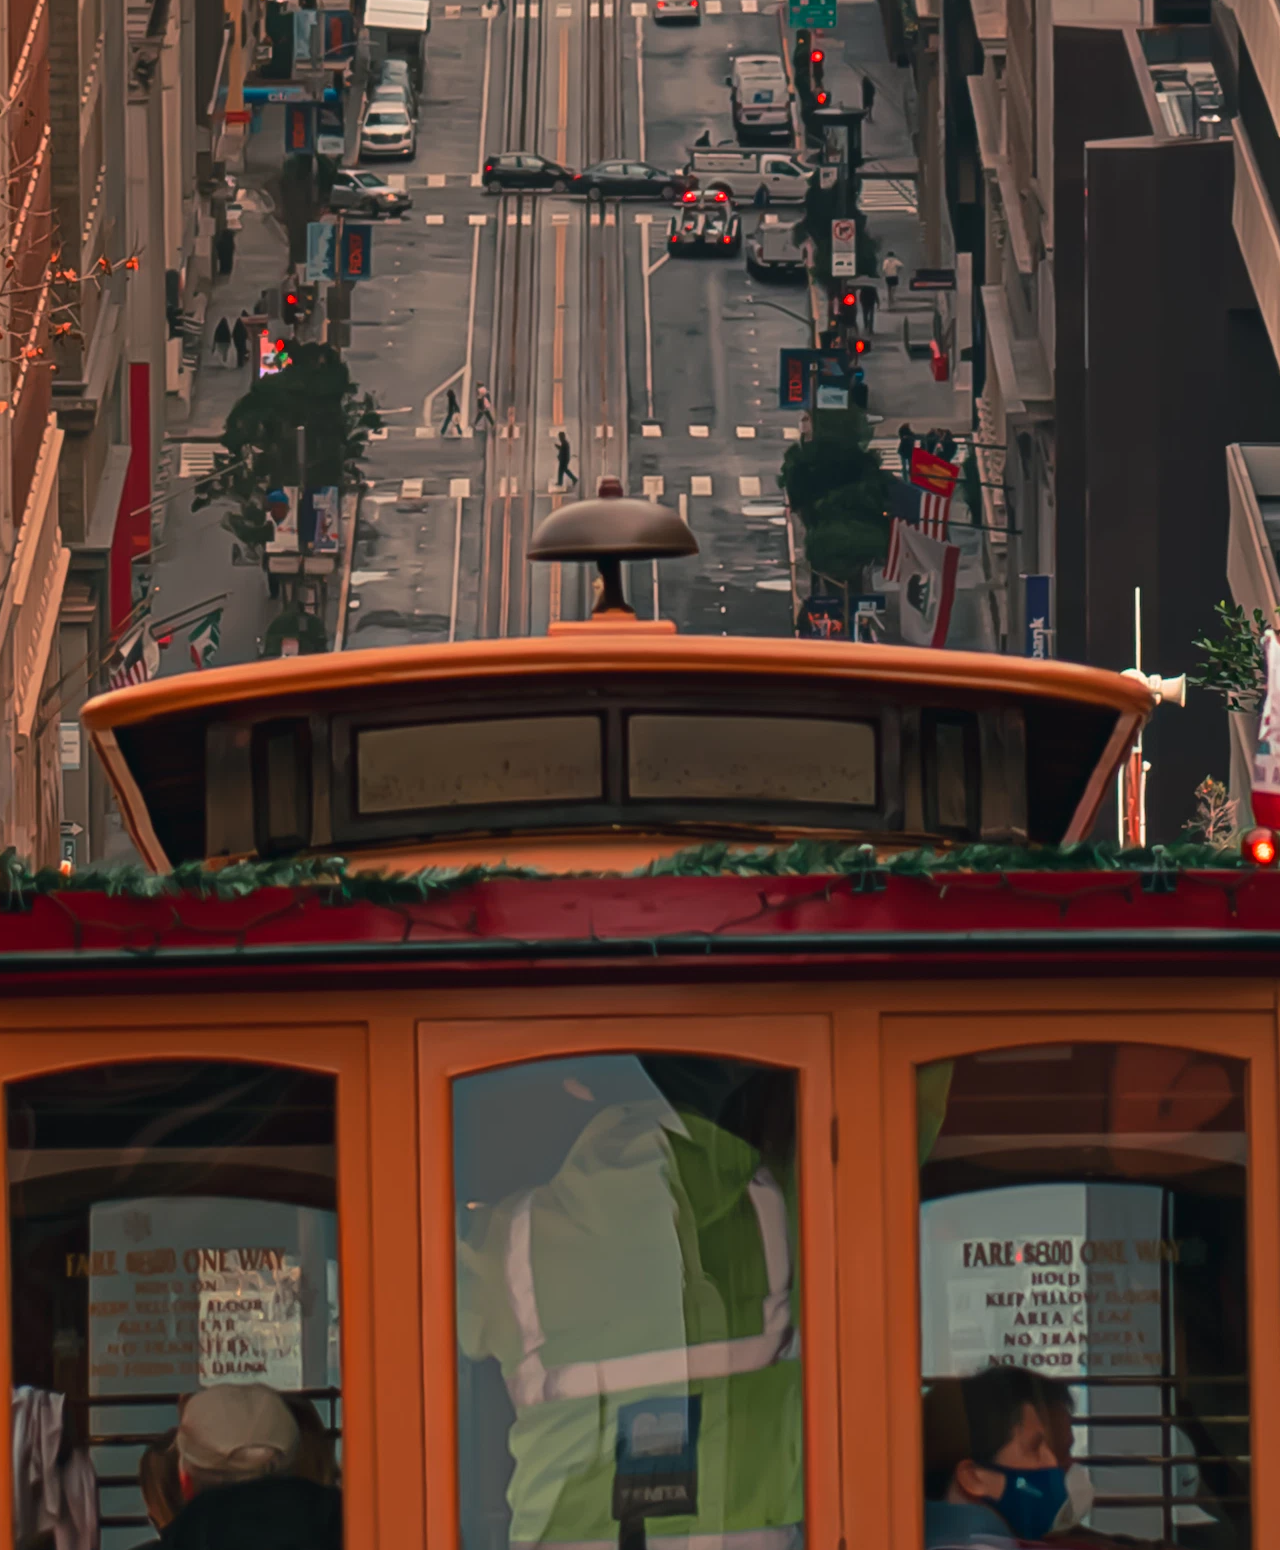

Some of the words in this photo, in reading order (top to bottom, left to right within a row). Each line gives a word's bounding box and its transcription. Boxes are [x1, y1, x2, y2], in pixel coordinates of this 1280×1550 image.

[183, 1248, 230, 1273] ONE
[238, 1247, 286, 1272] WAY
[963, 1241, 1015, 1268] FARE
[1031, 1271, 1080, 1286] HOLD
[1014, 1311, 1064, 1326] AREA
[1004, 1332, 1032, 1347] NO
[988, 1354, 1015, 1368] NO
[1023, 1353, 1073, 1367] FOOD
